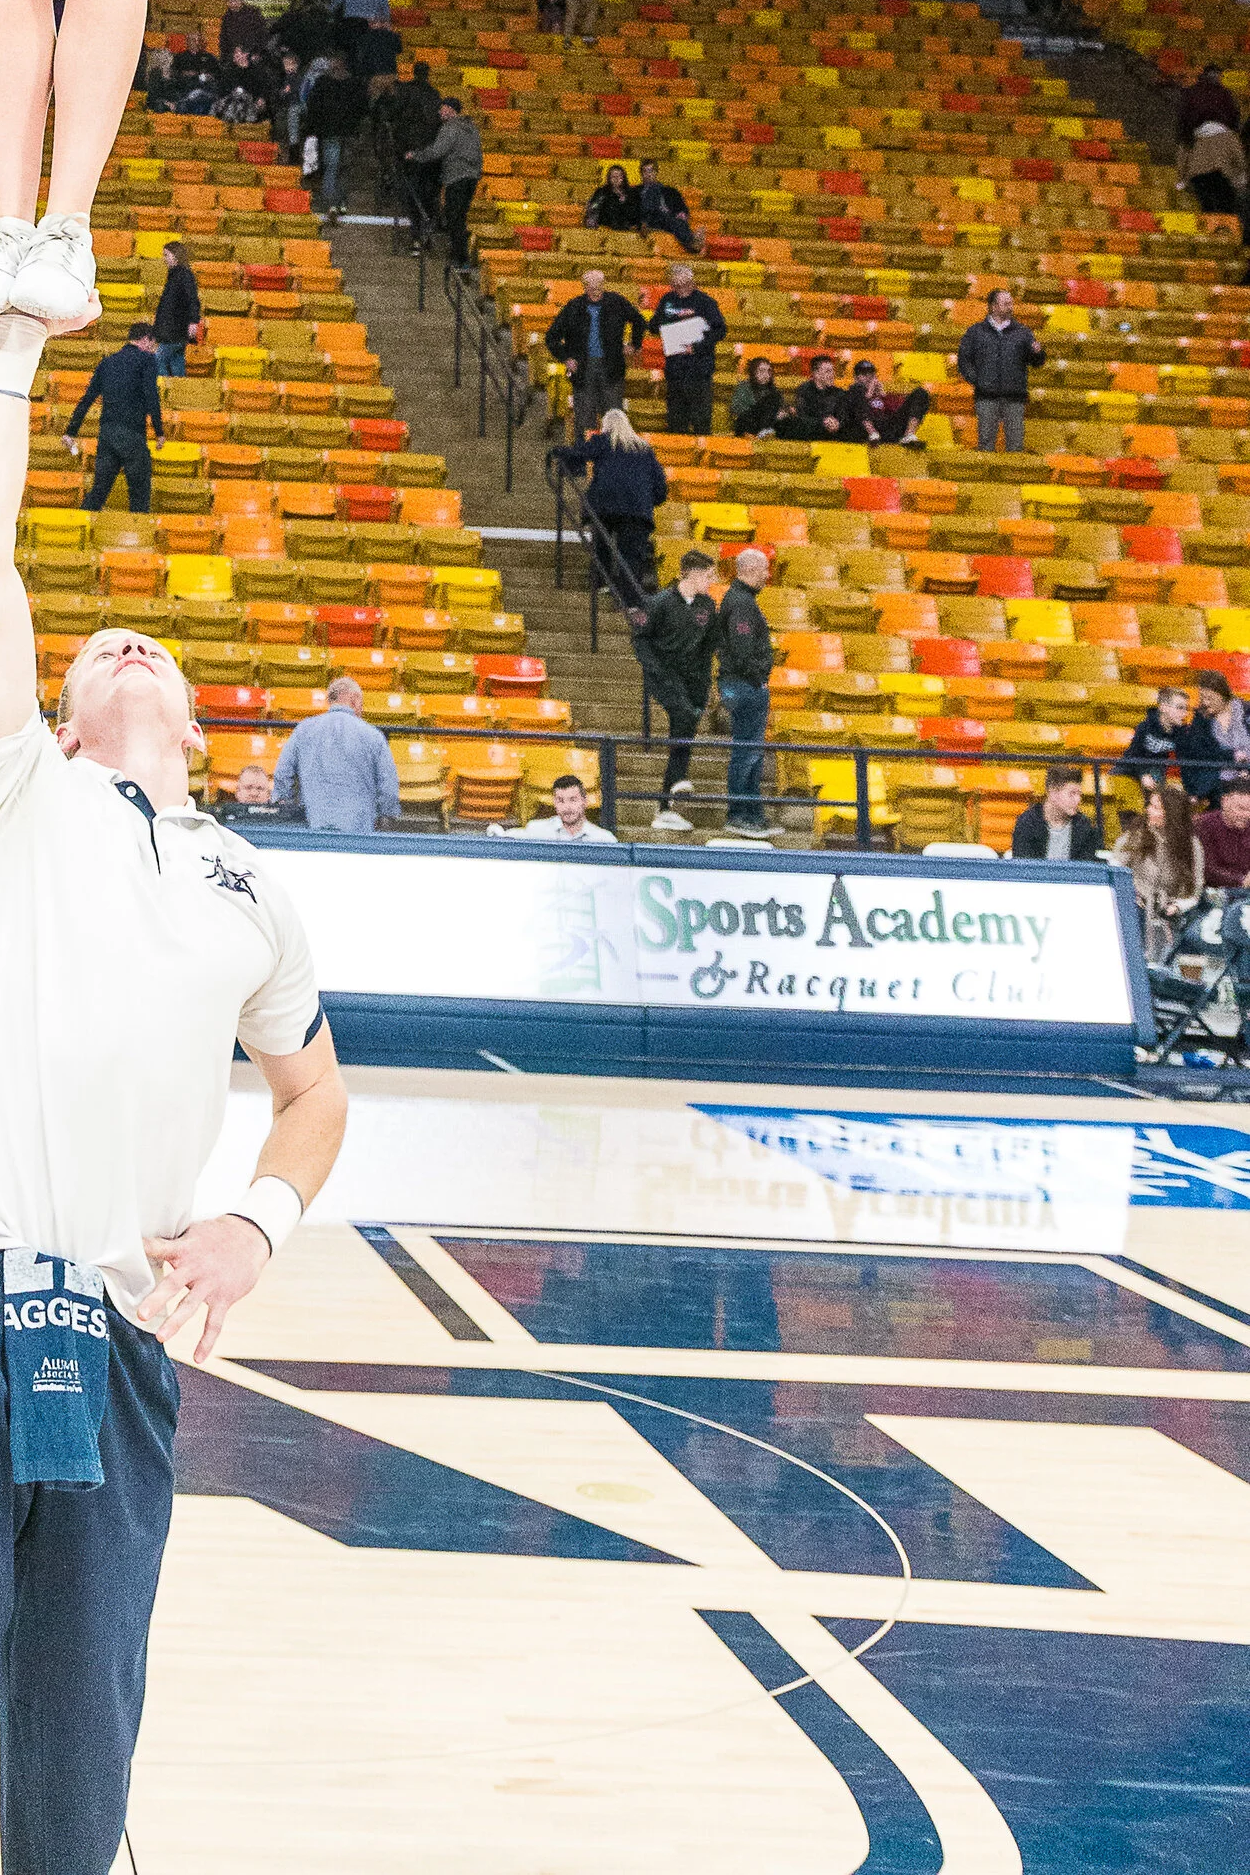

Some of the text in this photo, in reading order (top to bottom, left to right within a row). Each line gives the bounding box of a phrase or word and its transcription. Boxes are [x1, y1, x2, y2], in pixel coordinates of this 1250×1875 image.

[637, 872, 1052, 963] Sports Academy
[690, 950, 737, 999] &
[743, 959, 923, 1011] Racquet
